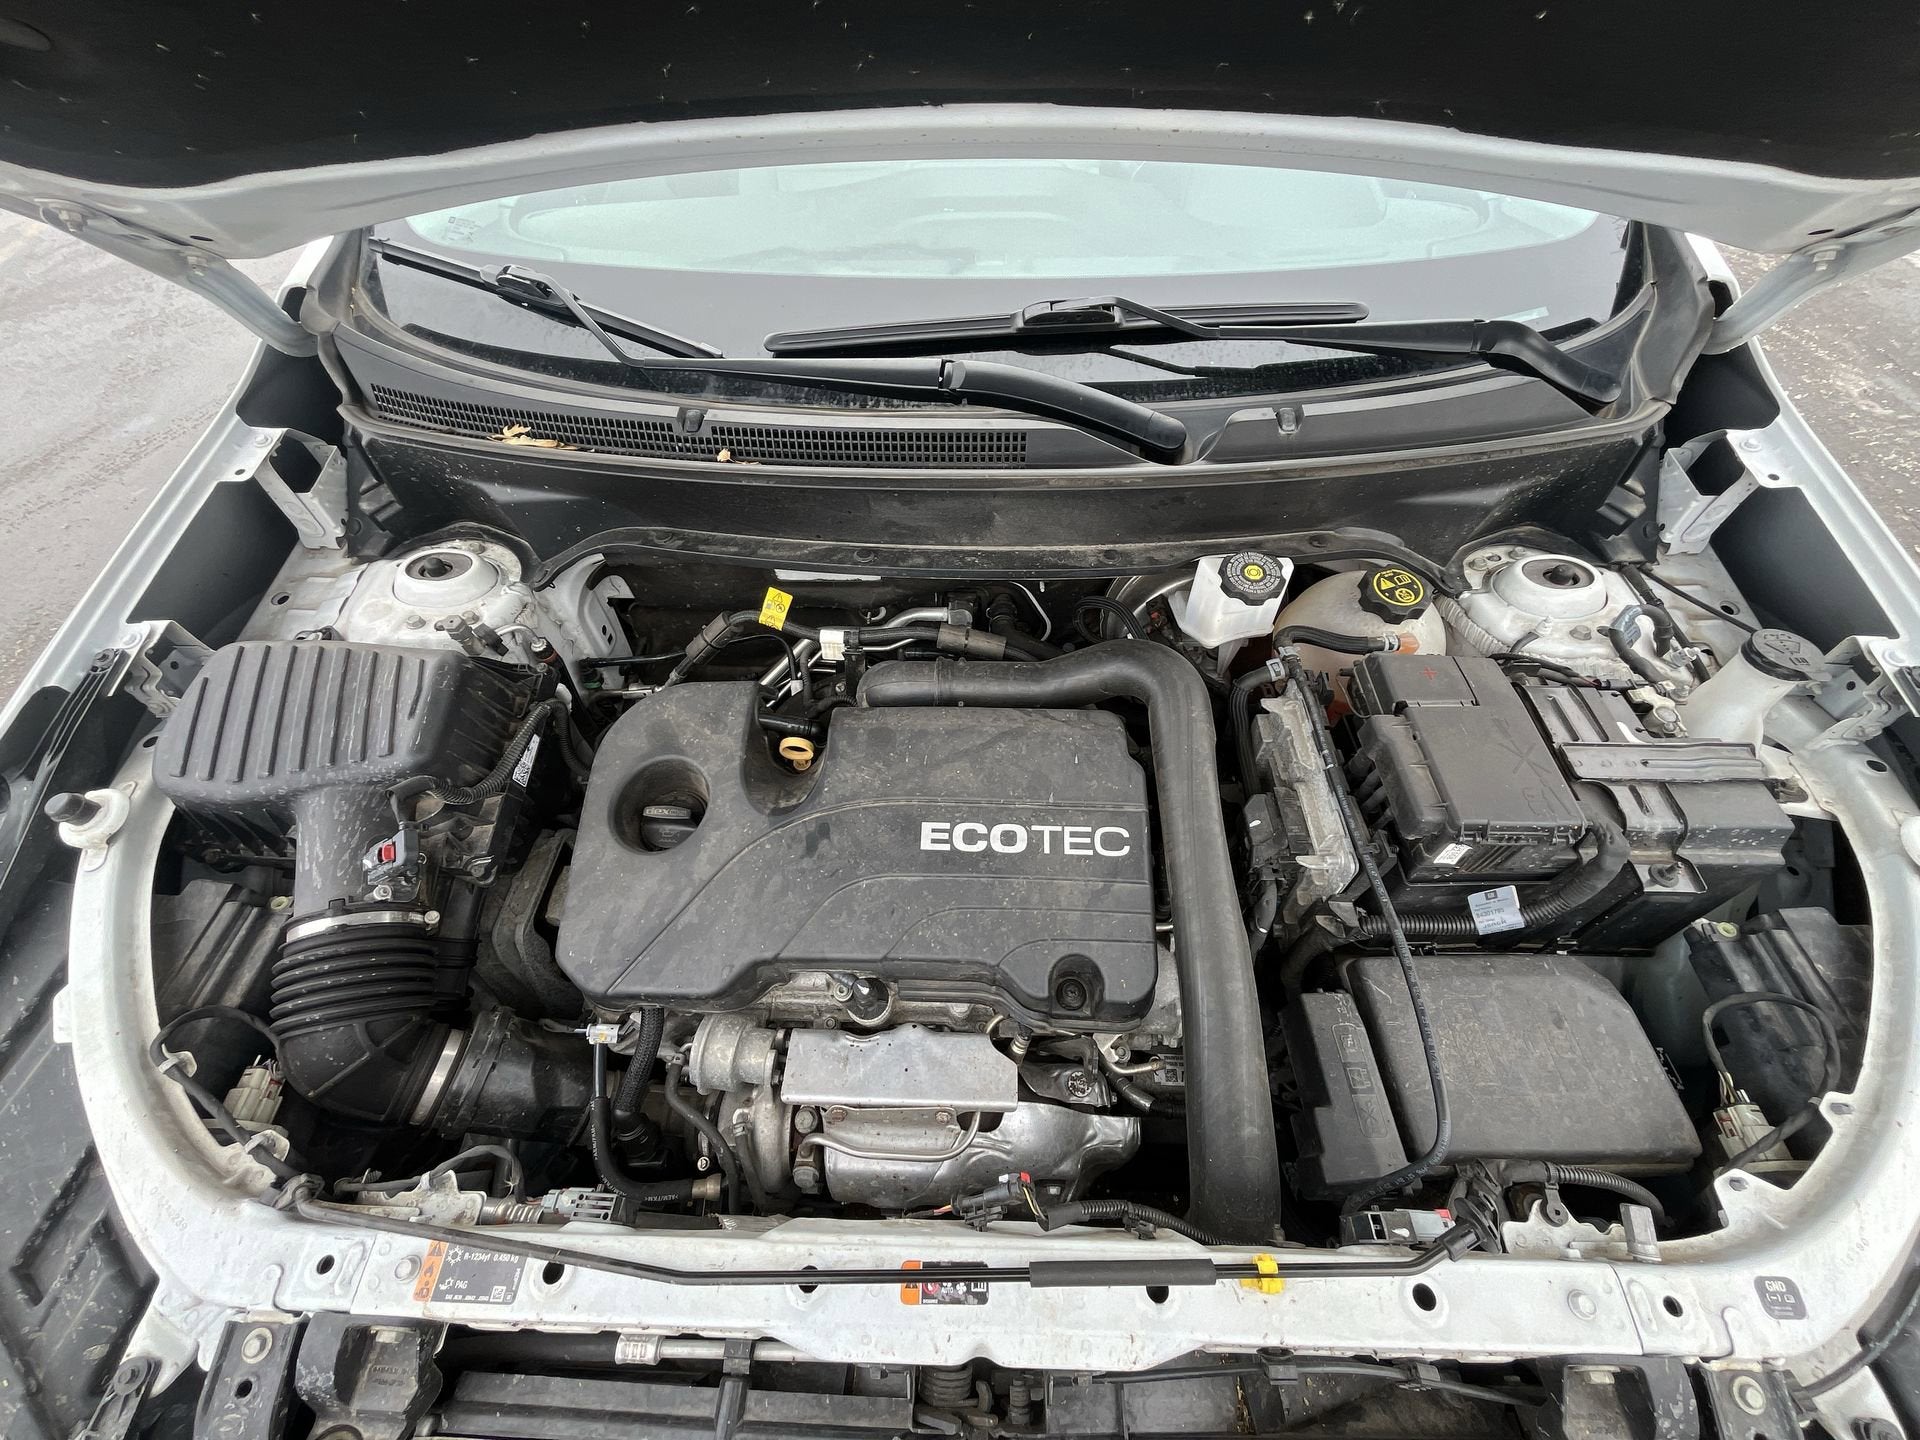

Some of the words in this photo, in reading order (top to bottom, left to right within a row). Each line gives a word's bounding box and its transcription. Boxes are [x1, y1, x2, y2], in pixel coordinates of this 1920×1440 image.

[920, 821, 1131, 857] ECOTEC
[454, 1280, 468, 1289] PAG
[941, 1286, 954, 1294] AUTO
[1764, 1280, 1787, 1293] GND
